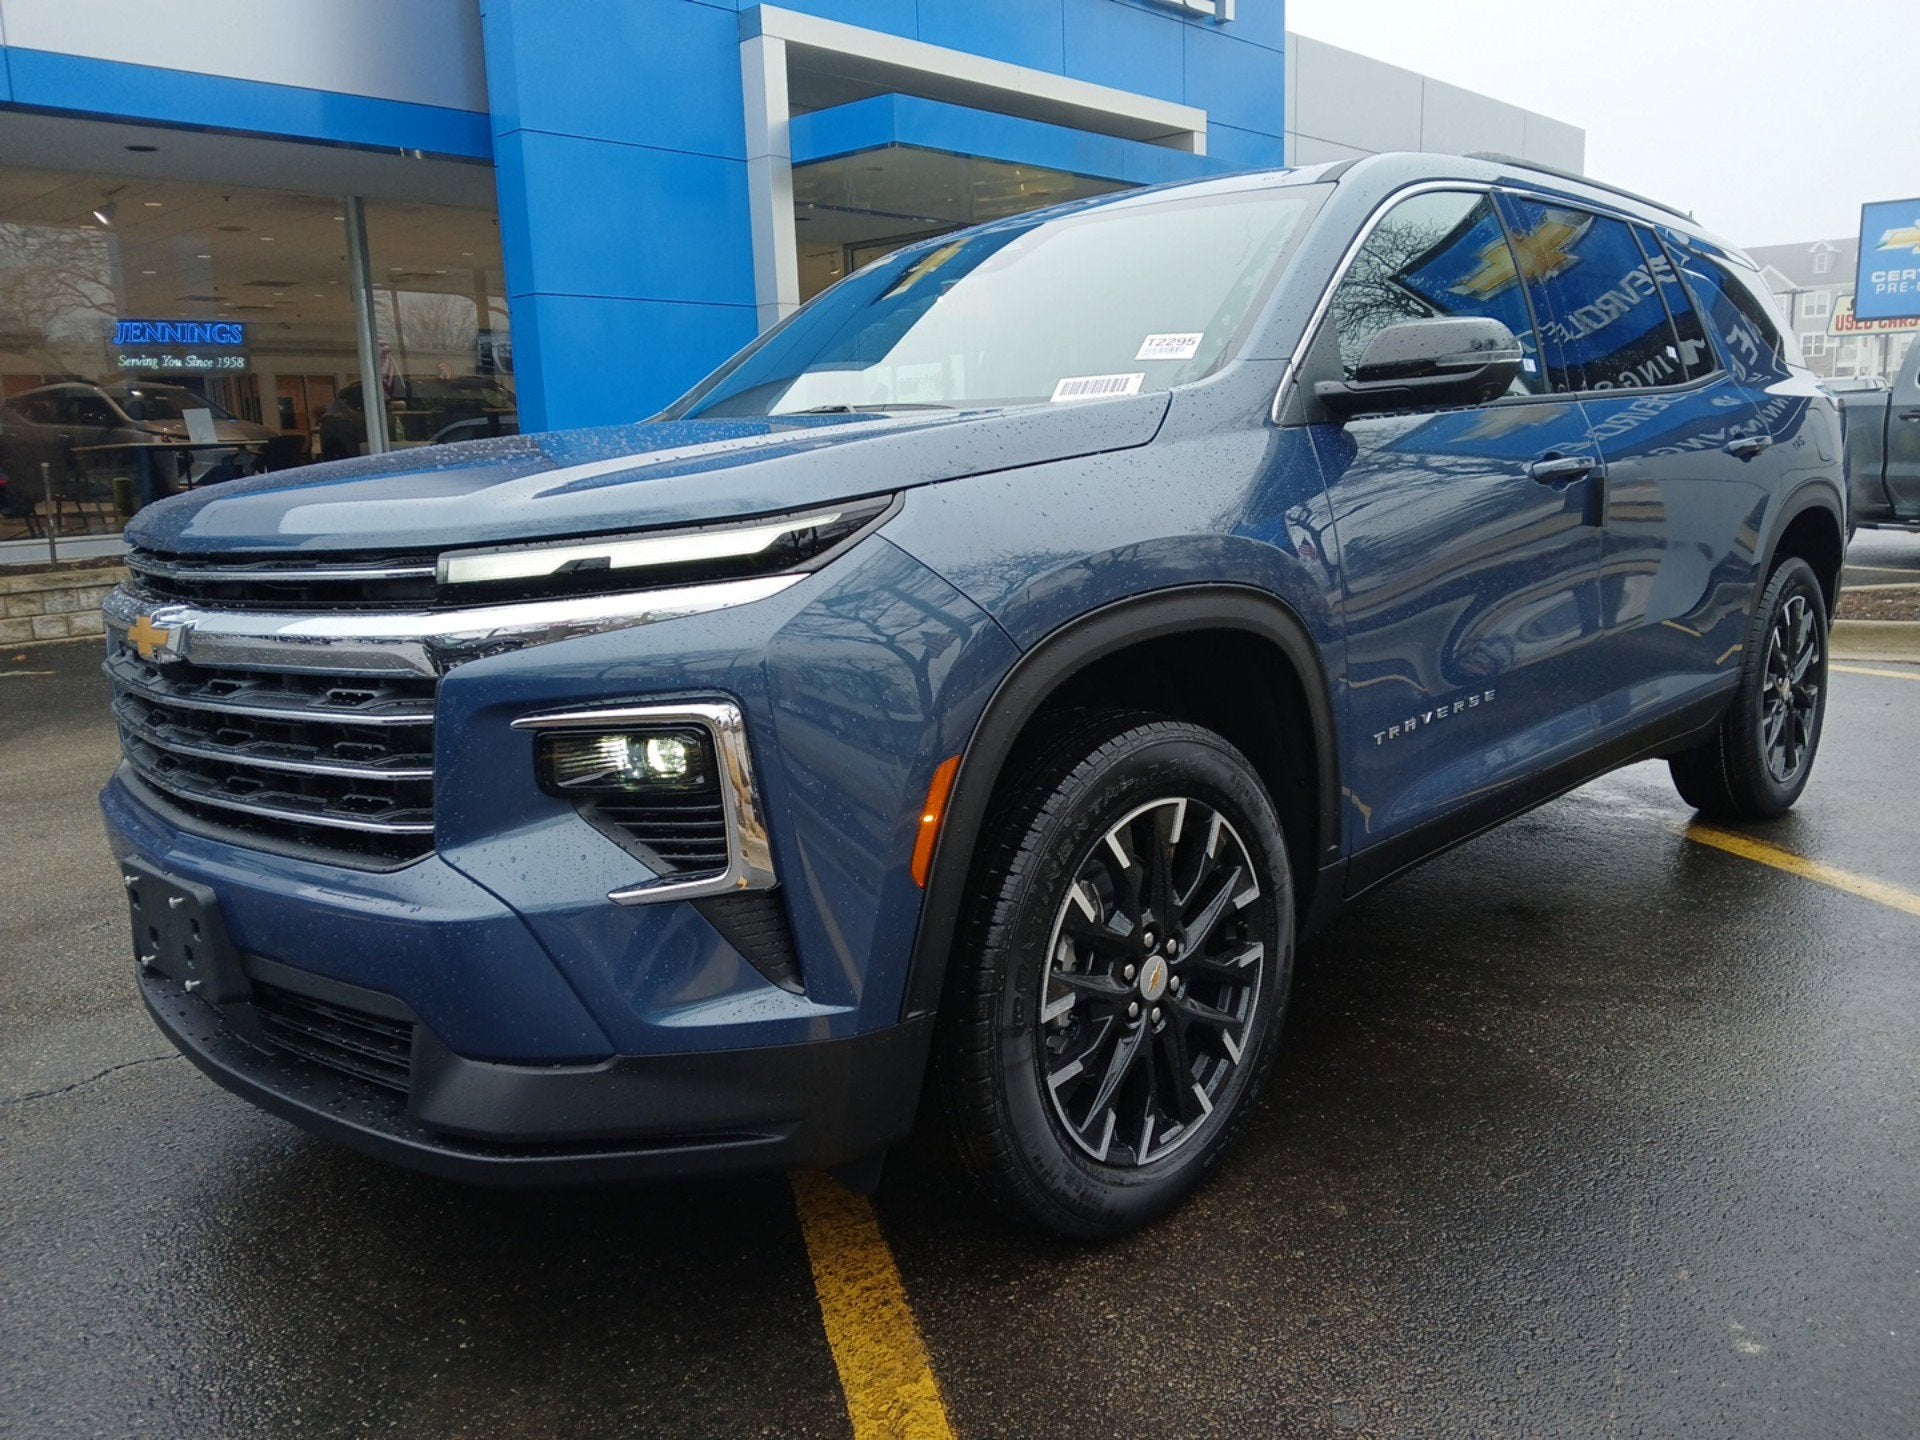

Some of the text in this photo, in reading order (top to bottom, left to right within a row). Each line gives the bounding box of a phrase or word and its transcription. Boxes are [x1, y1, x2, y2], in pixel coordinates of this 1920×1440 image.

[113, 322, 242, 344] JENNINGS
[1148, 336, 1197, 347] T2295
[118, 355, 245, 369] Serving You Since 1958
[1373, 688, 1496, 745] TRAVERSE
